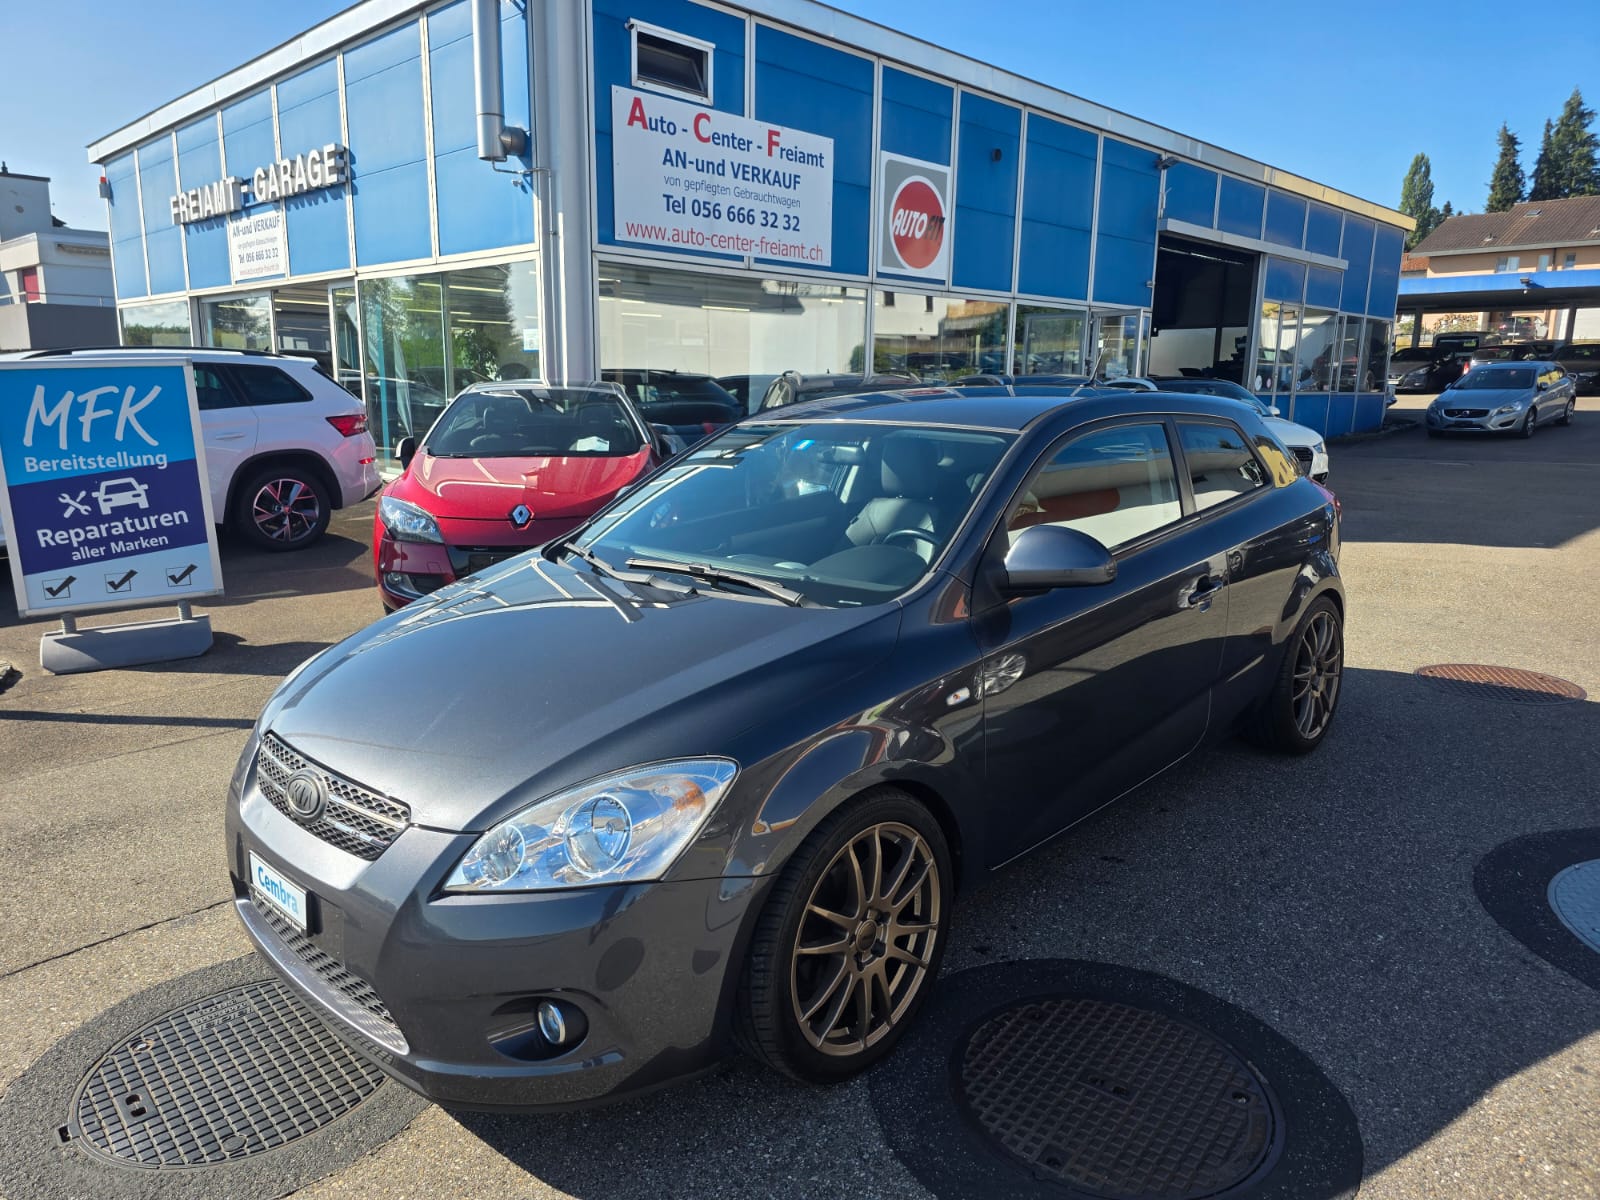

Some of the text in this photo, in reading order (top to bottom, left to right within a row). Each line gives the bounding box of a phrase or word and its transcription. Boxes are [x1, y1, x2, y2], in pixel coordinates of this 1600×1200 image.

[627, 96, 677, 136] Auto
[693, 112, 753, 152] Center
[767, 129, 825, 168] Freiamt
[170, 176, 240, 225] FREIAMT
[253, 143, 342, 202] GARAGE
[662, 148, 801, 191] AN-und VERKAUF
[664, 175, 801, 209] von gepflegten Gebrauchtwagen
[253, 214, 280, 233] VERKAUF
[662, 193, 801, 233] Tel 056 666 32 32
[625, 221, 824, 262] www.auto-center-freiamt.ch
[23, 384, 162, 450] MFK
[24, 451, 168, 473] Bereitstellung
[36, 509, 189, 548] Reparaturen
[71, 534, 169, 561] aller Marken
[257, 866, 299, 914] Cembra
